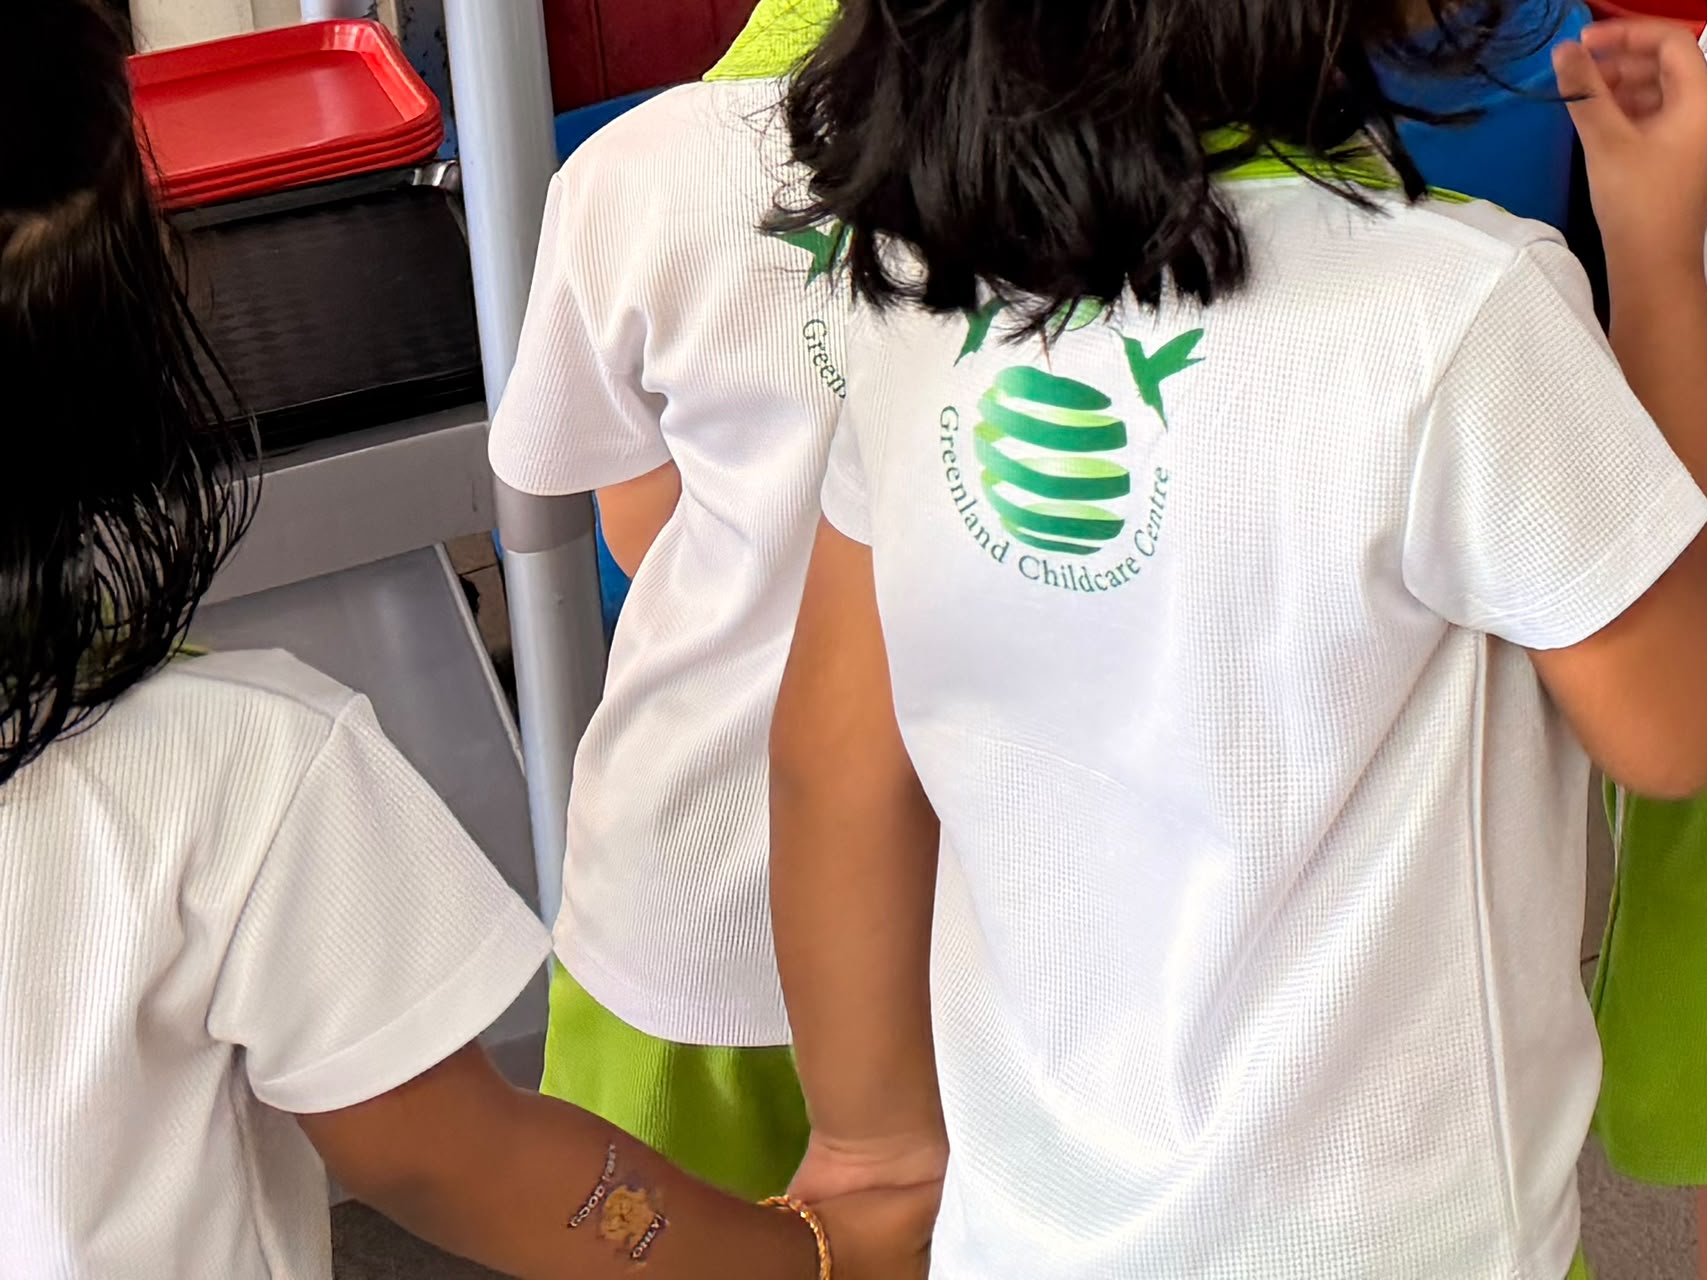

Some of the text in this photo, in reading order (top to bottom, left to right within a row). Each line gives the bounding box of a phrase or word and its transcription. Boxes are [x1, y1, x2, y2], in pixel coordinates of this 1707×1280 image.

[938, 404, 1171, 594] Greenland Childcare Centre
